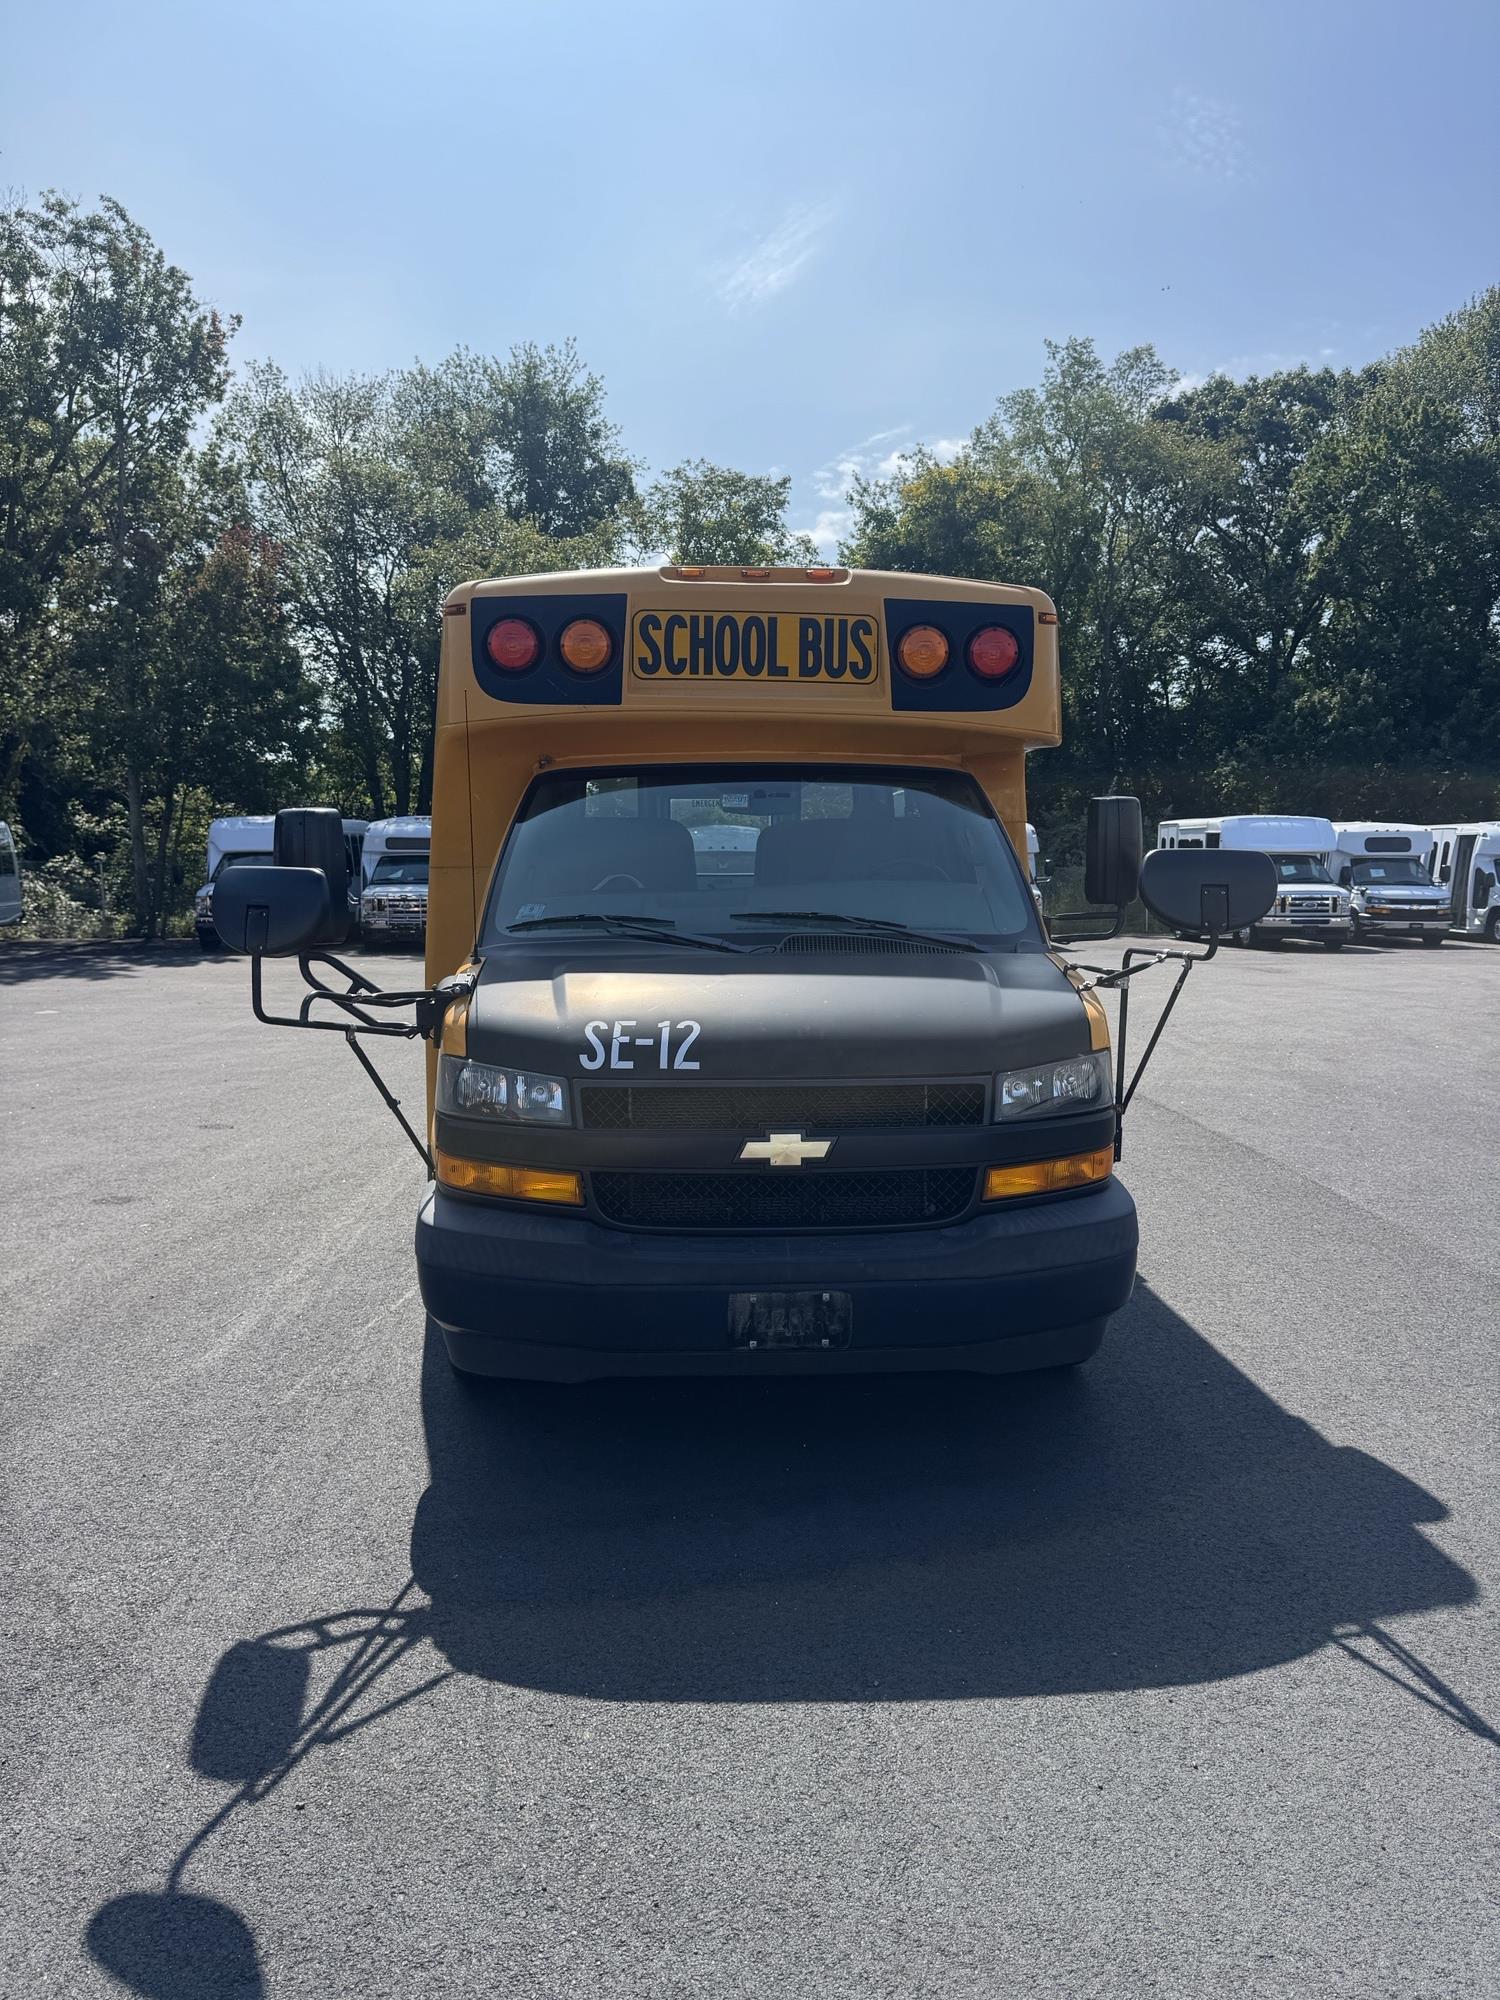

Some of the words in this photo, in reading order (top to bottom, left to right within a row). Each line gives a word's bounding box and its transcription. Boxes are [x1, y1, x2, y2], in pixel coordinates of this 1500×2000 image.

[638, 614, 789, 677] SCHOOL
[798, 617, 873, 680] BUS
[579, 1020, 701, 1070] SE-12
